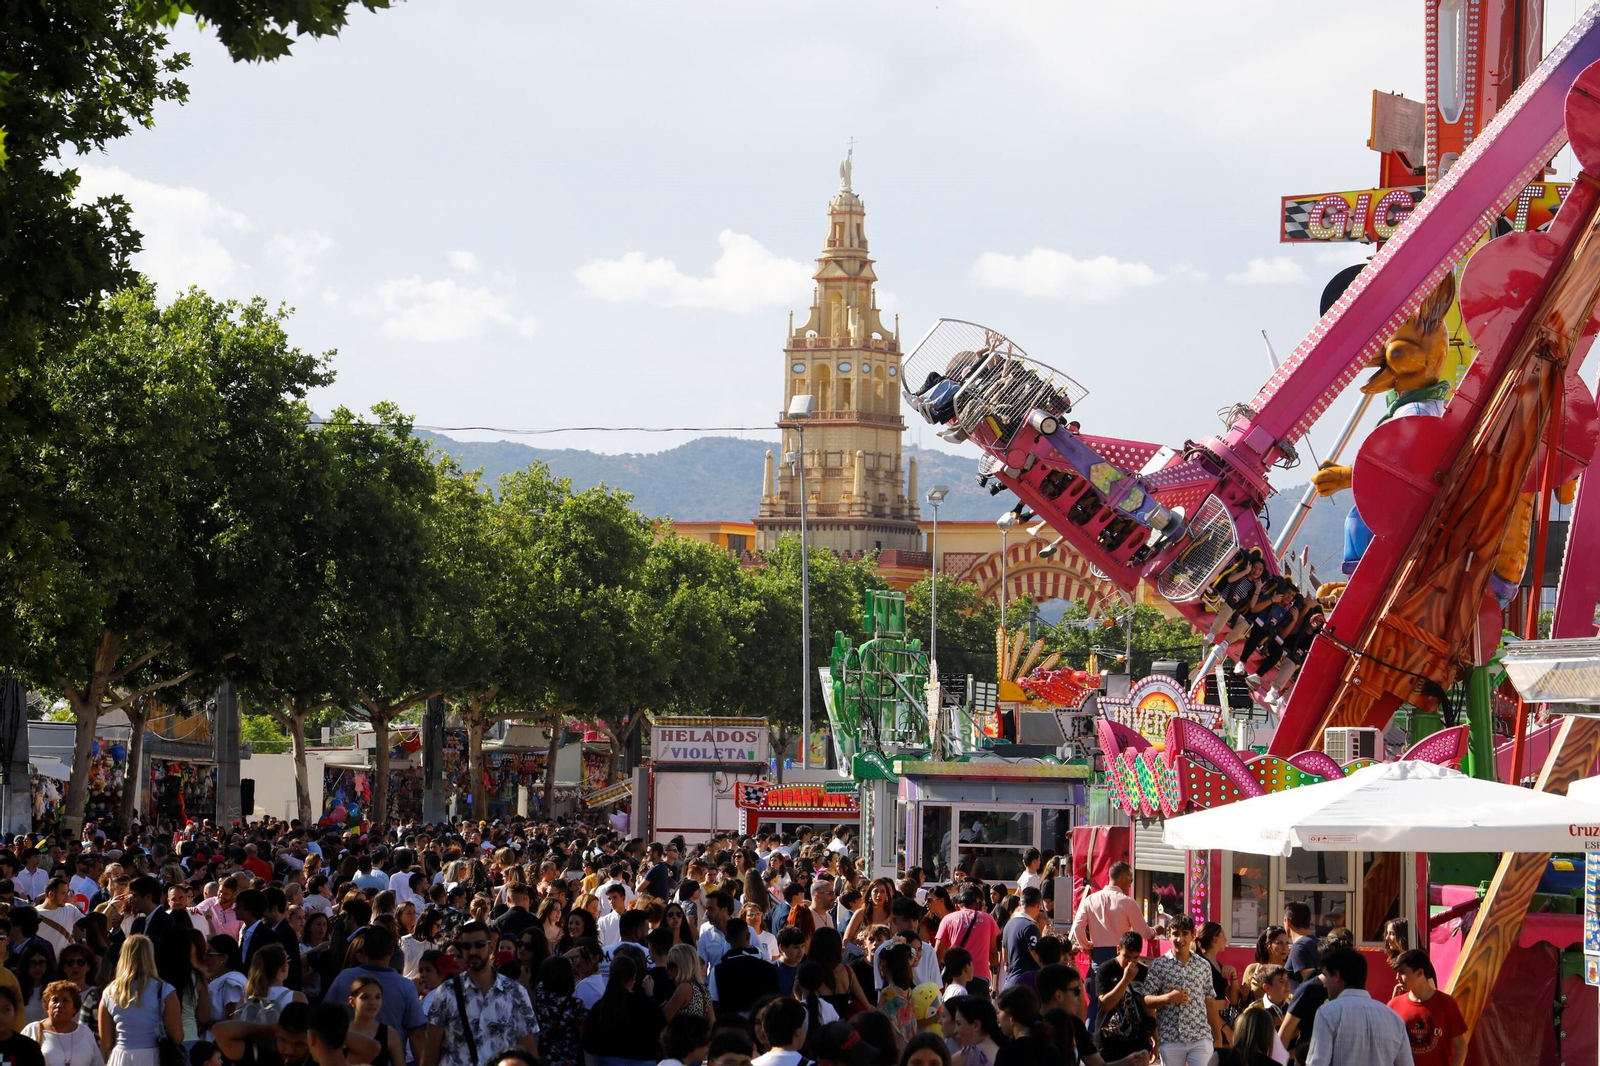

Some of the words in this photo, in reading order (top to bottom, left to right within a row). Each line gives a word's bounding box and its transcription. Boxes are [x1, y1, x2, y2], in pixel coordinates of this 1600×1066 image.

[661, 730, 758, 743] HELADOS
[671, 747, 747, 759] VIOLETA
[767, 788, 820, 807] GIGANT
[1569, 823, 1600, 837] Cruz
[1029, 935, 1038, 947] 3
